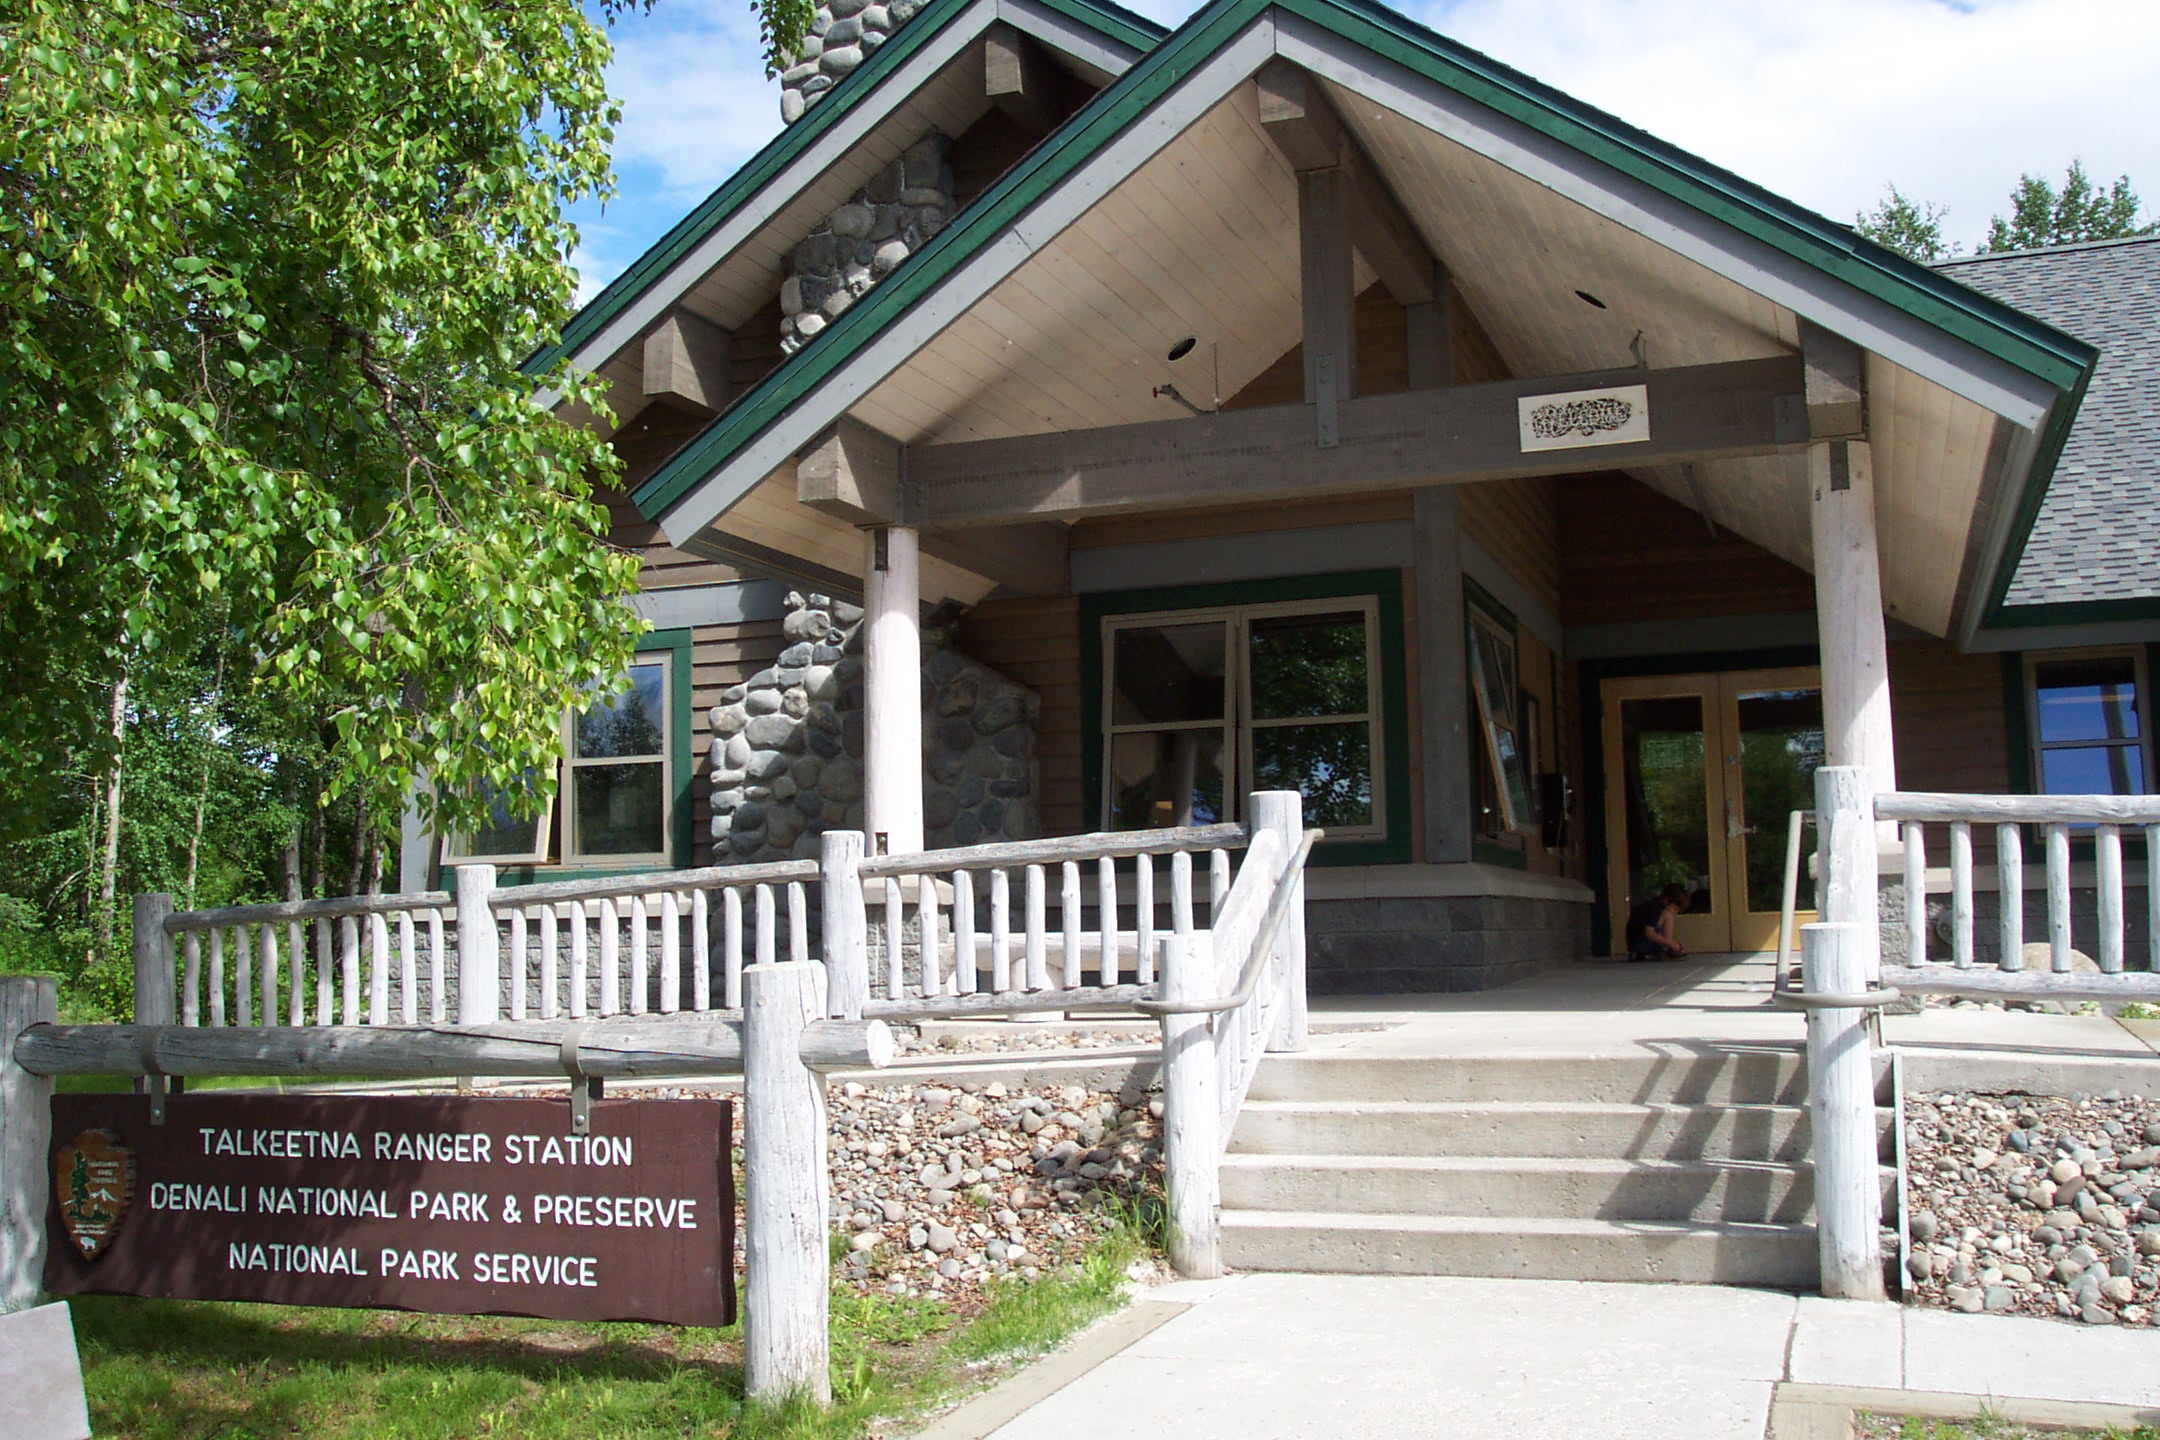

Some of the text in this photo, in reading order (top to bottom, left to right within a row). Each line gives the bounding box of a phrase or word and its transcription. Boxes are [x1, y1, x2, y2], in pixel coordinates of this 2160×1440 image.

[199, 1128, 633, 1167] TALKEETNA RANGER STATION
[150, 1183, 698, 1229] DENALI NATIONAL PARK & PRESERVE
[229, 1243, 598, 1288] NATIONAL PARK SERVICE
